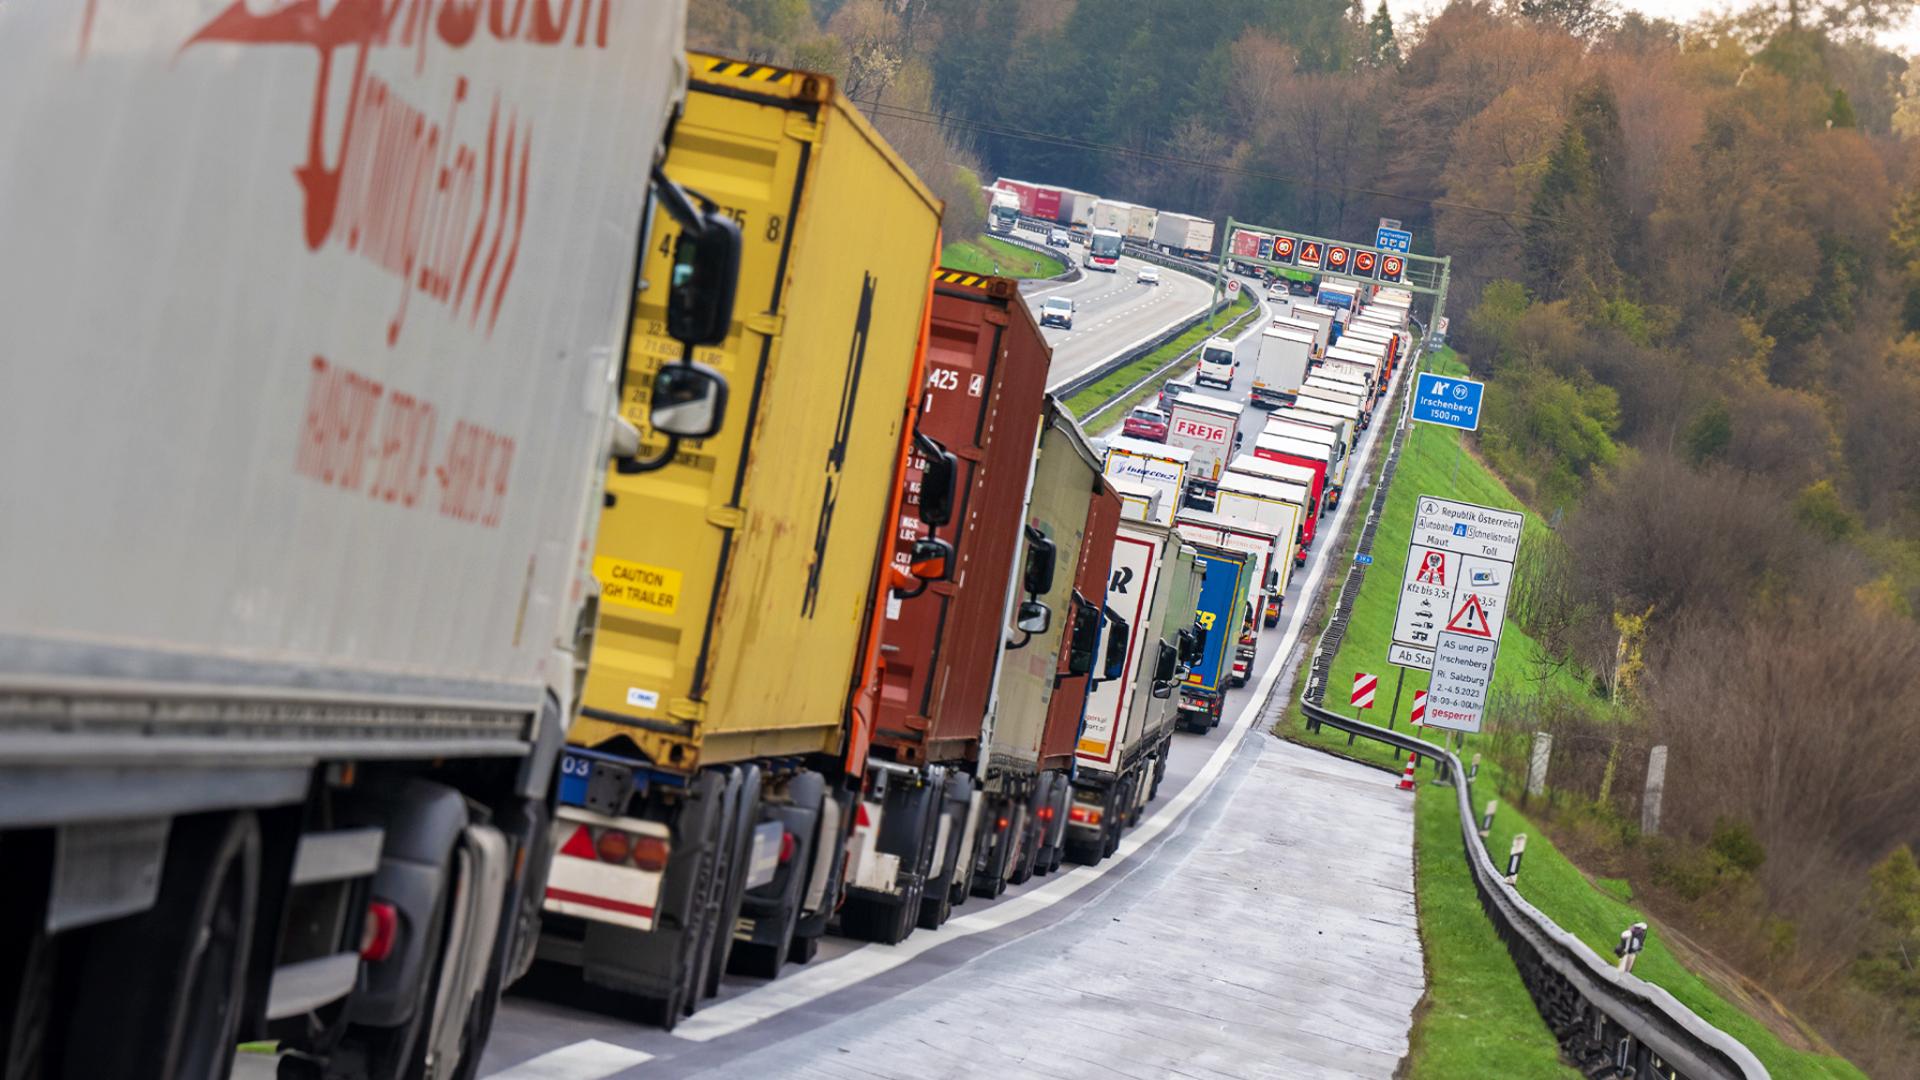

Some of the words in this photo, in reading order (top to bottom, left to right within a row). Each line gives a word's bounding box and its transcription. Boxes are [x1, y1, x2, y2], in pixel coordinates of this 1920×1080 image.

[766, 215, 780, 242] 8
[1333, 251, 1343, 261] 80
[1387, 261, 1398, 271] 80
[970, 376, 982, 395] 4
[1420, 396, 1474, 415] Irschenberg
[1431, 408, 1450, 420] 1500
[1451, 414, 1460, 422] m
[1177, 421, 1225, 441] FREJA
[1425, 503, 1433, 513] A
[1441, 507, 1476, 521] Republik
[1478, 514, 1519, 529] Österreich
[1418, 518, 1453, 532] Autobahn
[1469, 526, 1516, 544] Schnellstraße
[1426, 535, 1449, 547] Maut
[1482, 545, 1498, 556] Toll
[612, 564, 663, 587] CAUTION
[627, 586, 674, 608] TRAILER
[1406, 583, 1420, 593] Kfz
[1421, 586, 1433, 596] bis
[1434, 589, 1450, 599] 3,5t
[1443, 640, 1456, 649] AS
[1458, 643, 1474, 652] und
[1476, 645, 1489, 654] PP
[1398, 650, 1412, 661] Ab
[1414, 653, 1432, 665] Sta
[1440, 654, 1488, 671] Irschenberg
[1437, 669, 1447, 679] Ri.
[1450, 671, 1485, 687] Salzburg
[1431, 708, 1476, 722] gesperrt!
